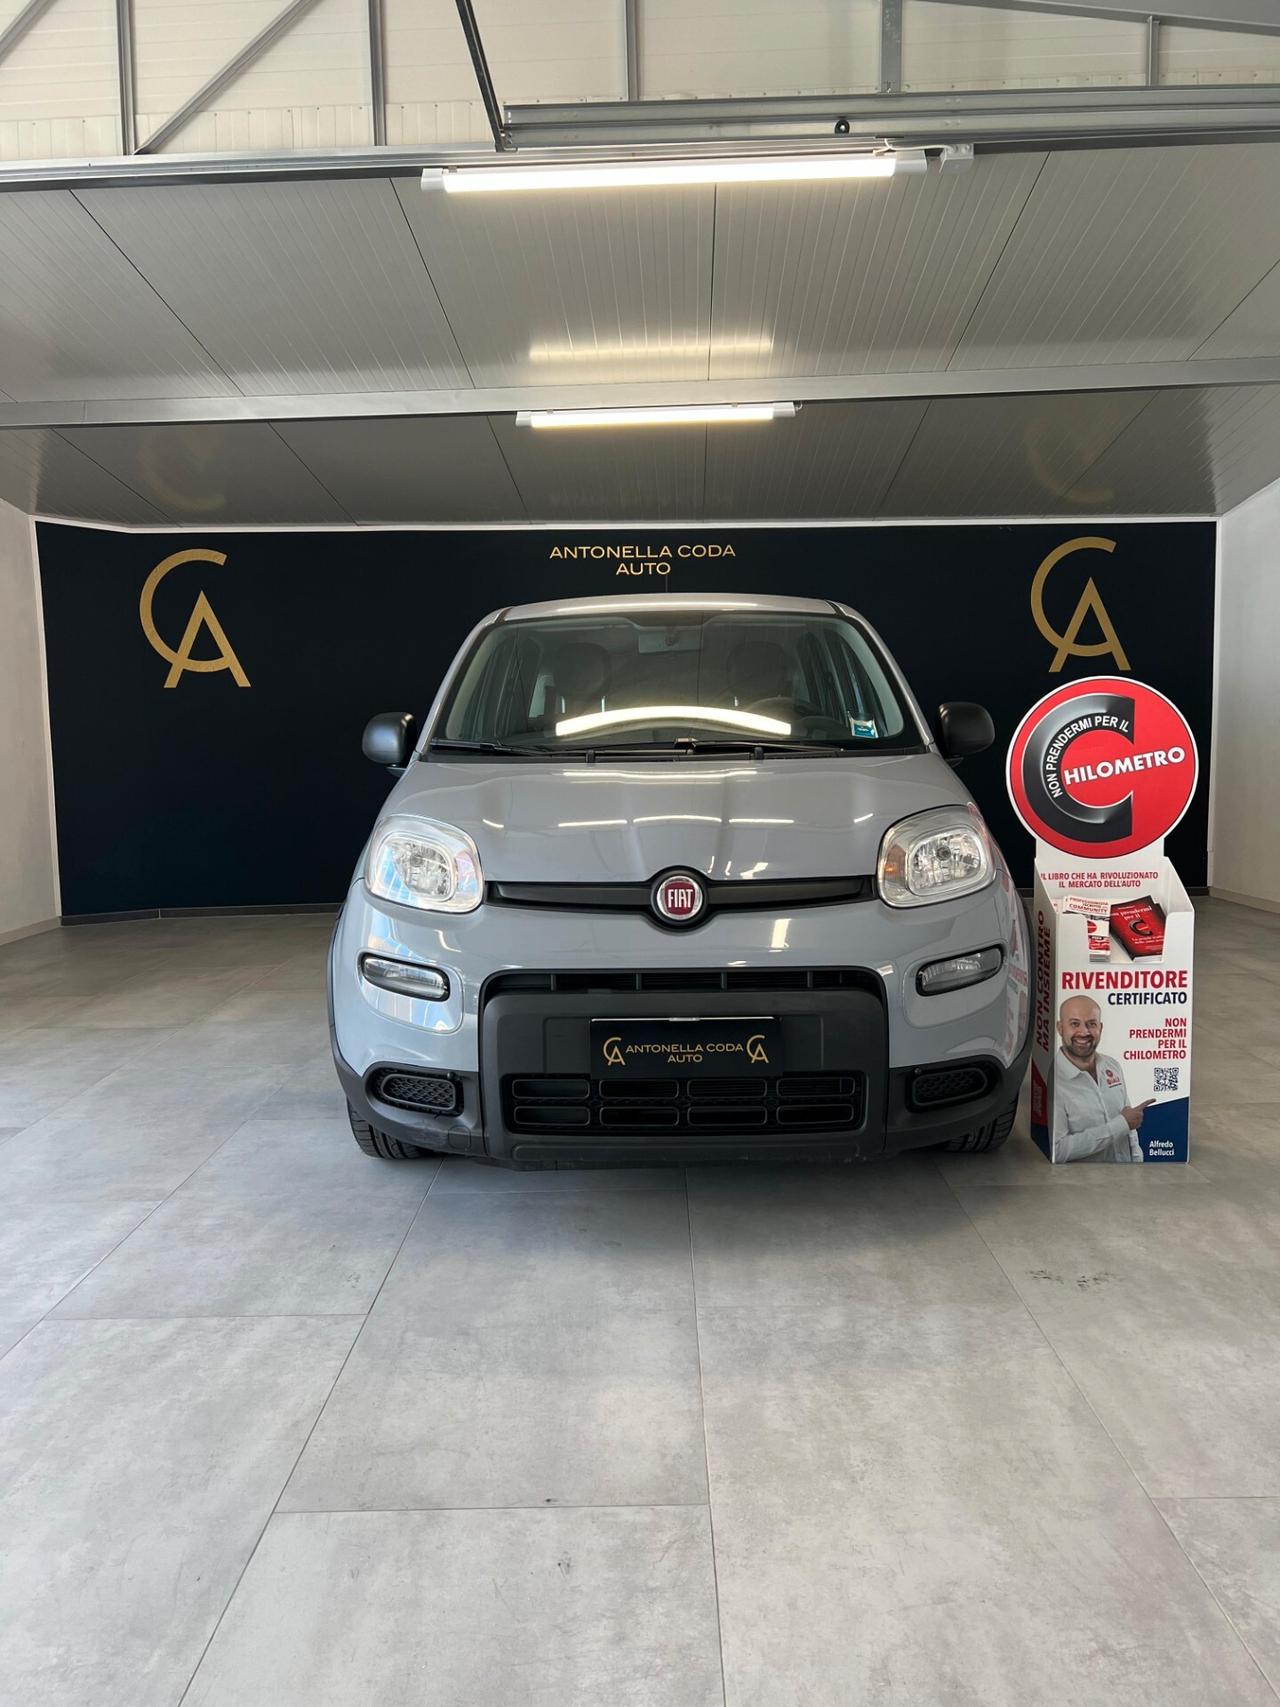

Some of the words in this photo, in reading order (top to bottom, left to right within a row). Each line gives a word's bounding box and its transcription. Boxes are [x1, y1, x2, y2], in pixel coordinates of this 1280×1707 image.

[549, 545, 673, 559] ANTONELLA
[677, 544, 736, 558] CODA
[615, 562, 671, 576] AUTO
[1094, 715, 1118, 728] PER
[1119, 719, 1130, 733] IL
[1045, 717, 1092, 771] PRENDERMI
[1046, 773, 1063, 798] NON
[1048, 872, 1069, 880] LIBRO
[1071, 872, 1085, 880] CHE
[1087, 872, 1097, 880] HA
[1100, 871, 1159, 880] RIVOLUZIONATO
[1058, 880, 1065, 888] IL
[1068, 880, 1102, 888] MERCATO
[1104, 879, 1141, 888] DELL'AUTO
[667, 888, 694, 908] FIAT
[1061, 970, 1188, 990] RIVENDITORE
[1107, 991, 1187, 1005] CERTIFICATO
[1165, 1018, 1187, 1027] NON
[1042, 1019, 1050, 1053] MA
[1129, 1029, 1187, 1039] PRENDERMI
[625, 1044, 704, 1054] ANTONELLA
[706, 1043, 744, 1053] CODA
[1158, 1039, 1176, 1049] PER
[1178, 1039, 1187, 1048] IL
[667, 1055, 703, 1063] AUTO
[1123, 1050, 1187, 1060] CHILOMETRO
[1149, 1148, 1175, 1156] Bellucci
